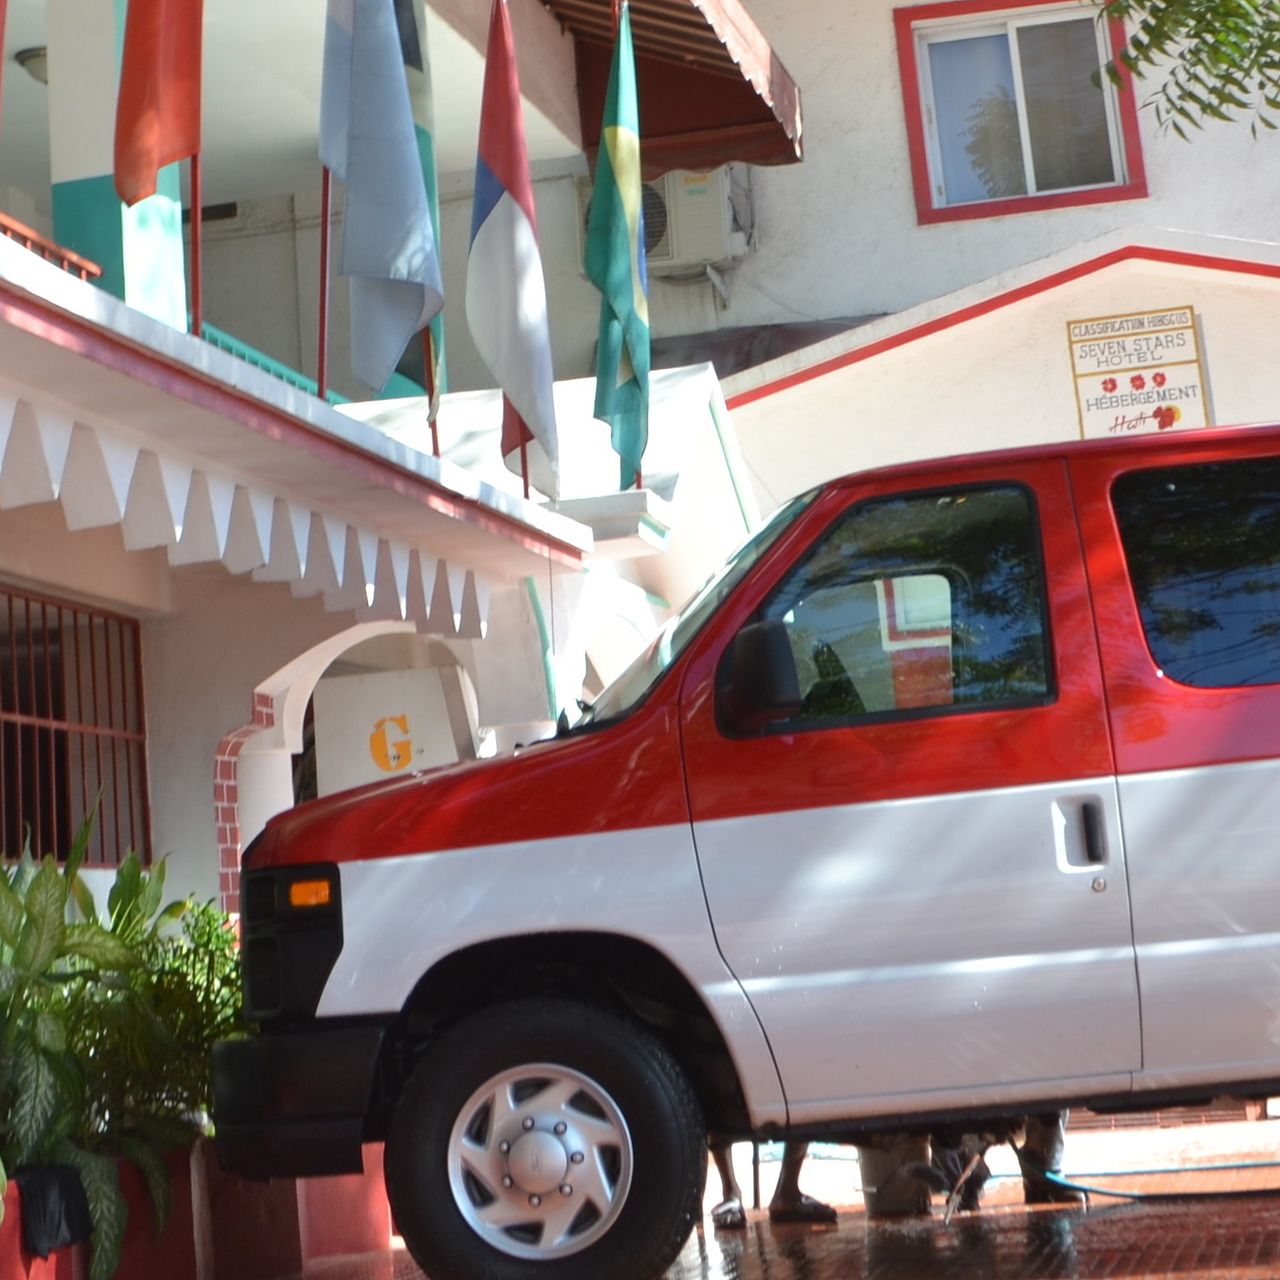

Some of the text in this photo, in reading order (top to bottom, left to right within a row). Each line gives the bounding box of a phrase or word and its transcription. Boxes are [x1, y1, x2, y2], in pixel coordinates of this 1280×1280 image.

[1072, 311, 1189, 338] CLASSIFICATION HIBISCUS
[1079, 333, 1187, 359] SEVEN STARS
[1096, 350, 1163, 368] HOTEL
[369, 713, 412, 772] G
